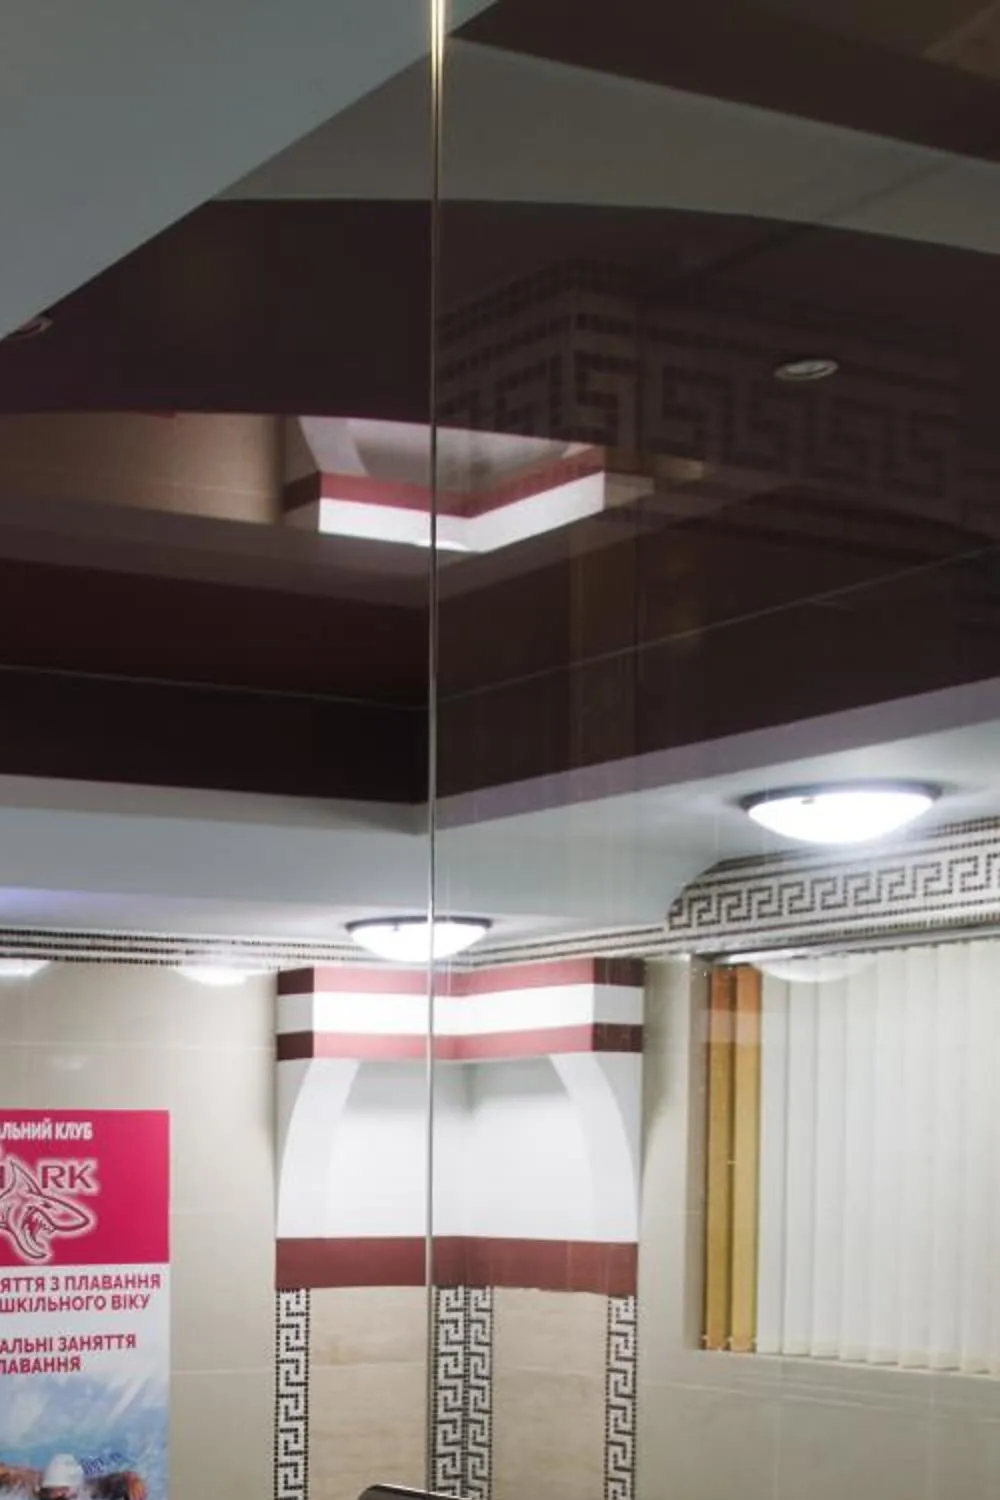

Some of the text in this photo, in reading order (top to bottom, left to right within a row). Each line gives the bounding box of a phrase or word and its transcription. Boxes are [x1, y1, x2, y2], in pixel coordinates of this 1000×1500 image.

[55, 1121, 93, 1140] КЛУБ
[64, 1273, 161, 1291] ПЛАВАННЯ
[111, 1294, 150, 1310] ВІКУ
[58, 1334, 136, 1352] ЗАНЯТТЯ
